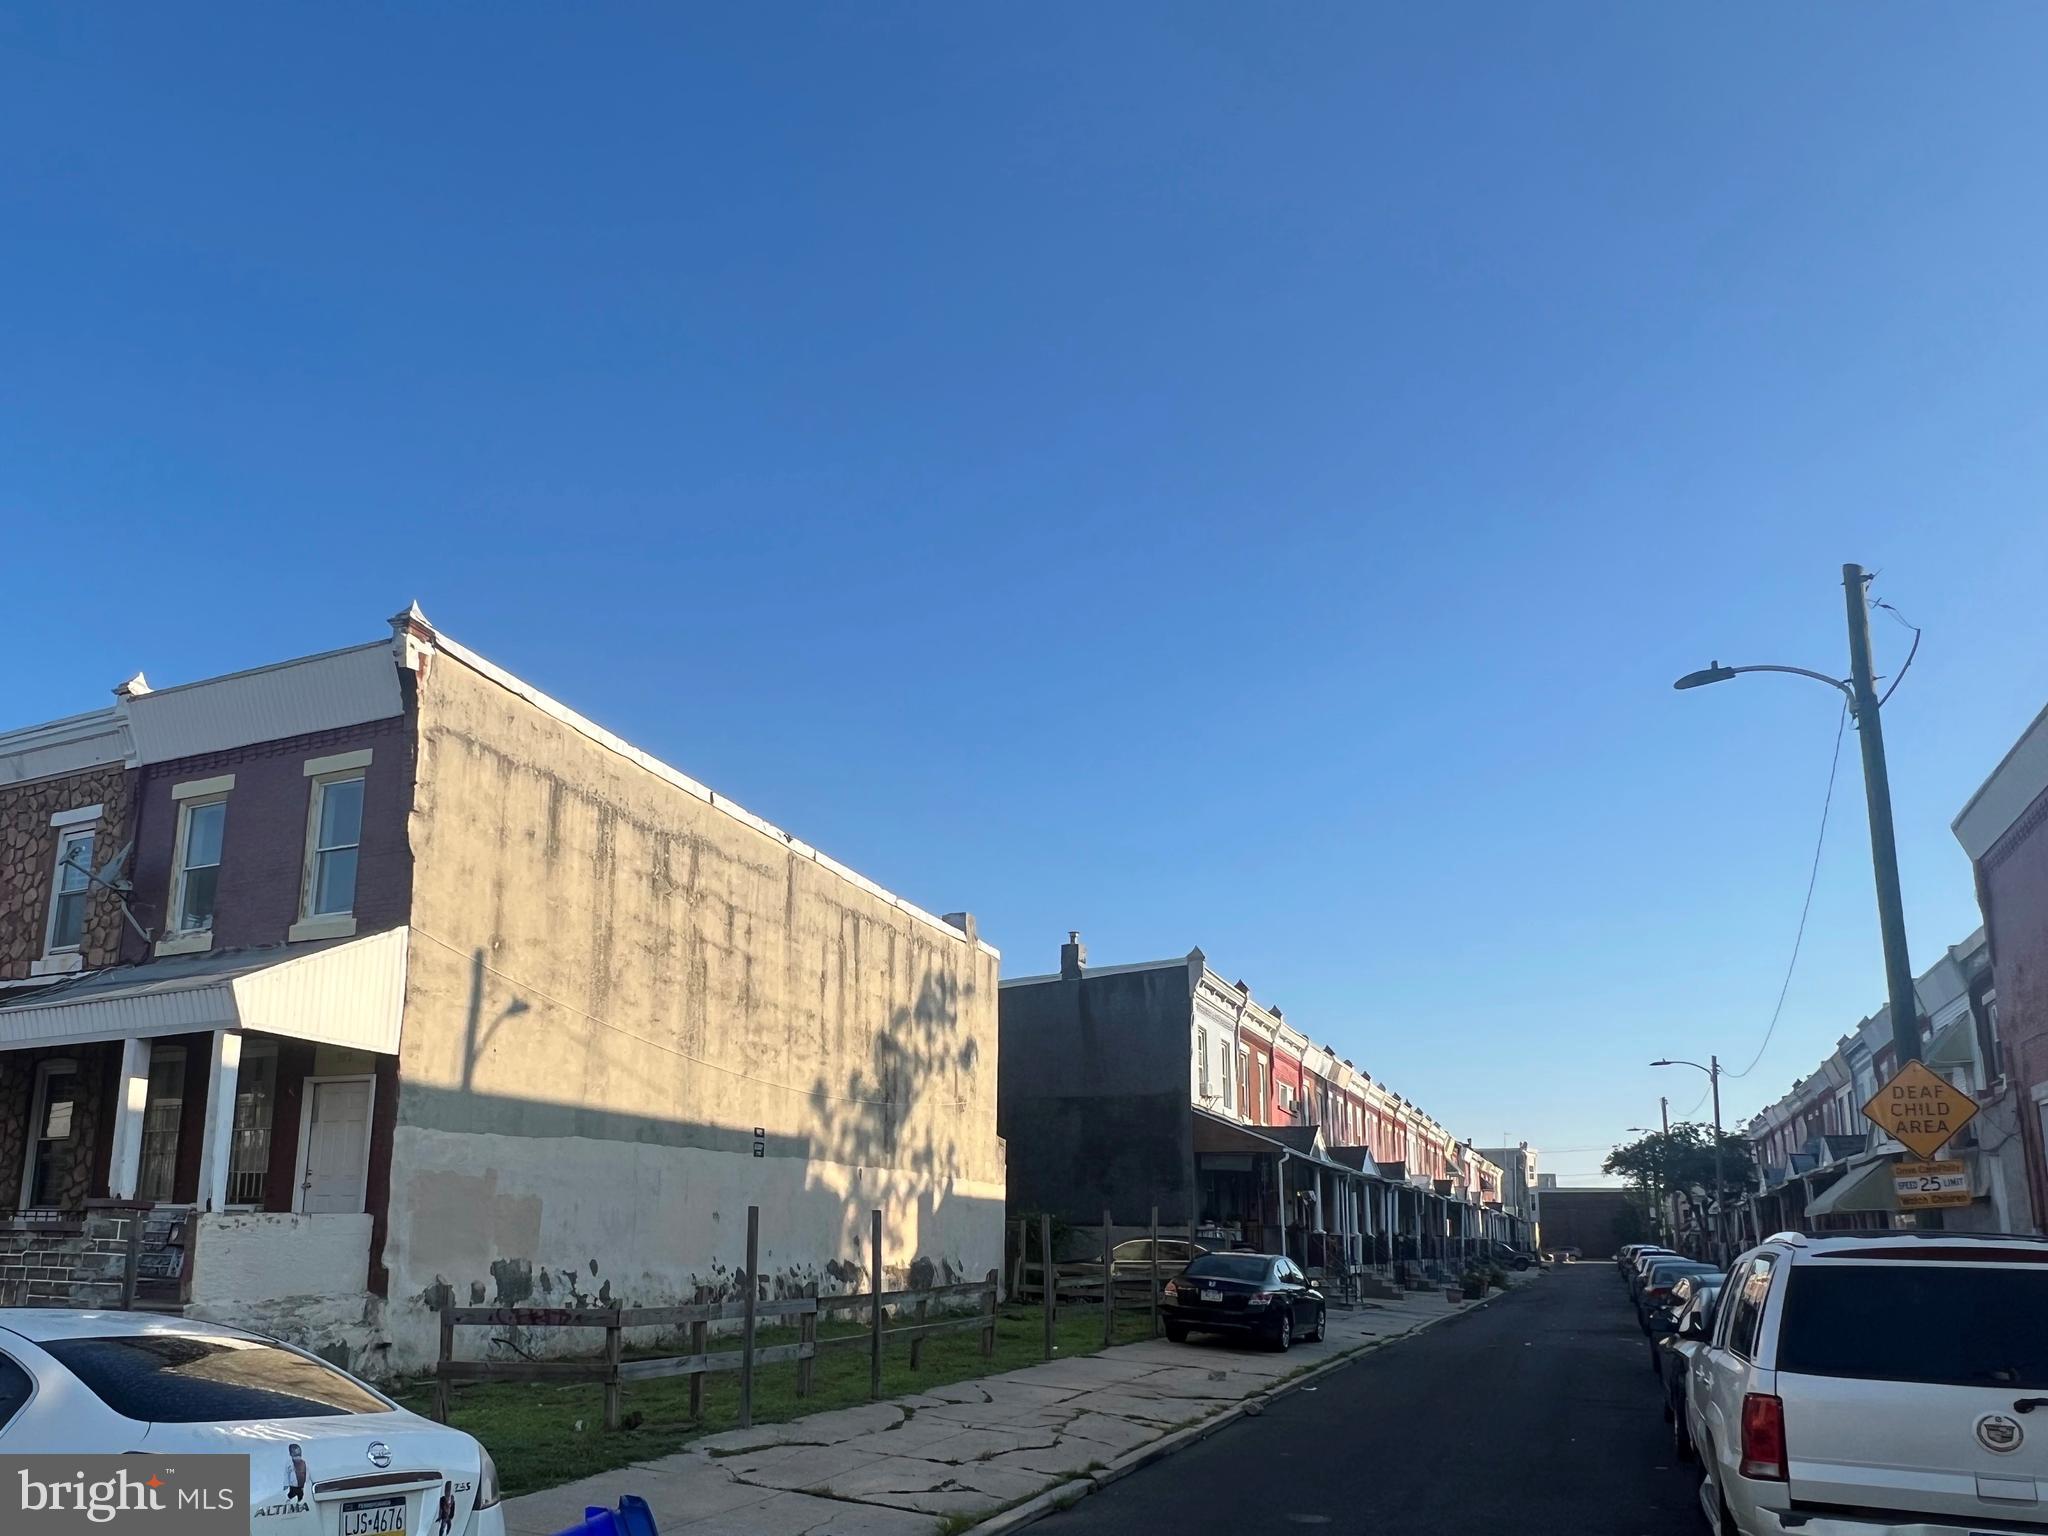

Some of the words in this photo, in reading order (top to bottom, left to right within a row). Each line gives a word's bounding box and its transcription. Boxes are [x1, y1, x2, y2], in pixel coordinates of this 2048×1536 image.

[1892, 1085, 1944, 1099] DEAF
[1890, 1102, 1950, 1117] CHILD
[1896, 1119, 1950, 1134] AREA
[1897, 1180, 1918, 1190] SPEED
[1919, 1176, 1942, 1192] 25
[1943, 1177, 1964, 1187] LIMIT
[254, 1502, 310, 1518] ALTIMA
